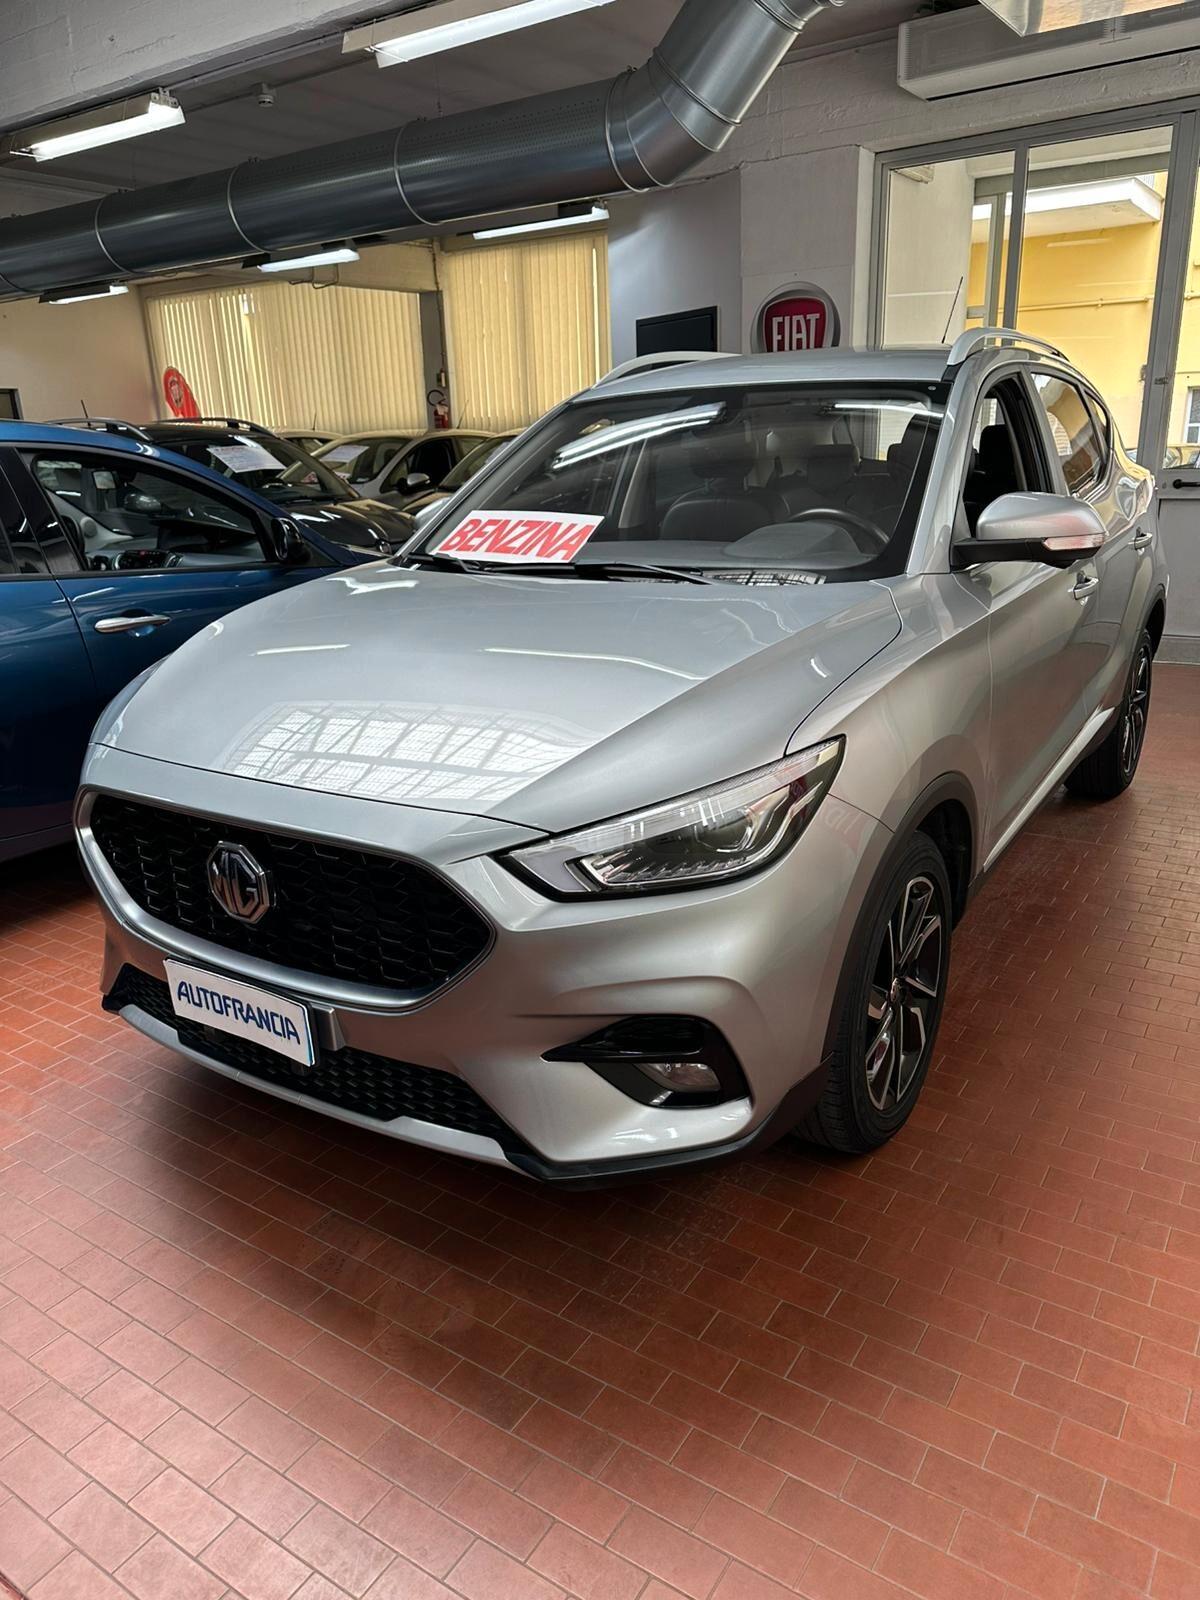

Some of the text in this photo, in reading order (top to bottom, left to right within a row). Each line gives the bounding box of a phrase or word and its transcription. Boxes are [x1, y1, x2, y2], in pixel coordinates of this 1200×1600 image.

[772, 313, 820, 353] FIAT
[439, 518, 596, 560] BENZINA
[211, 850, 259, 915] MG
[177, 980, 301, 1045] AUTOFRANCIA
